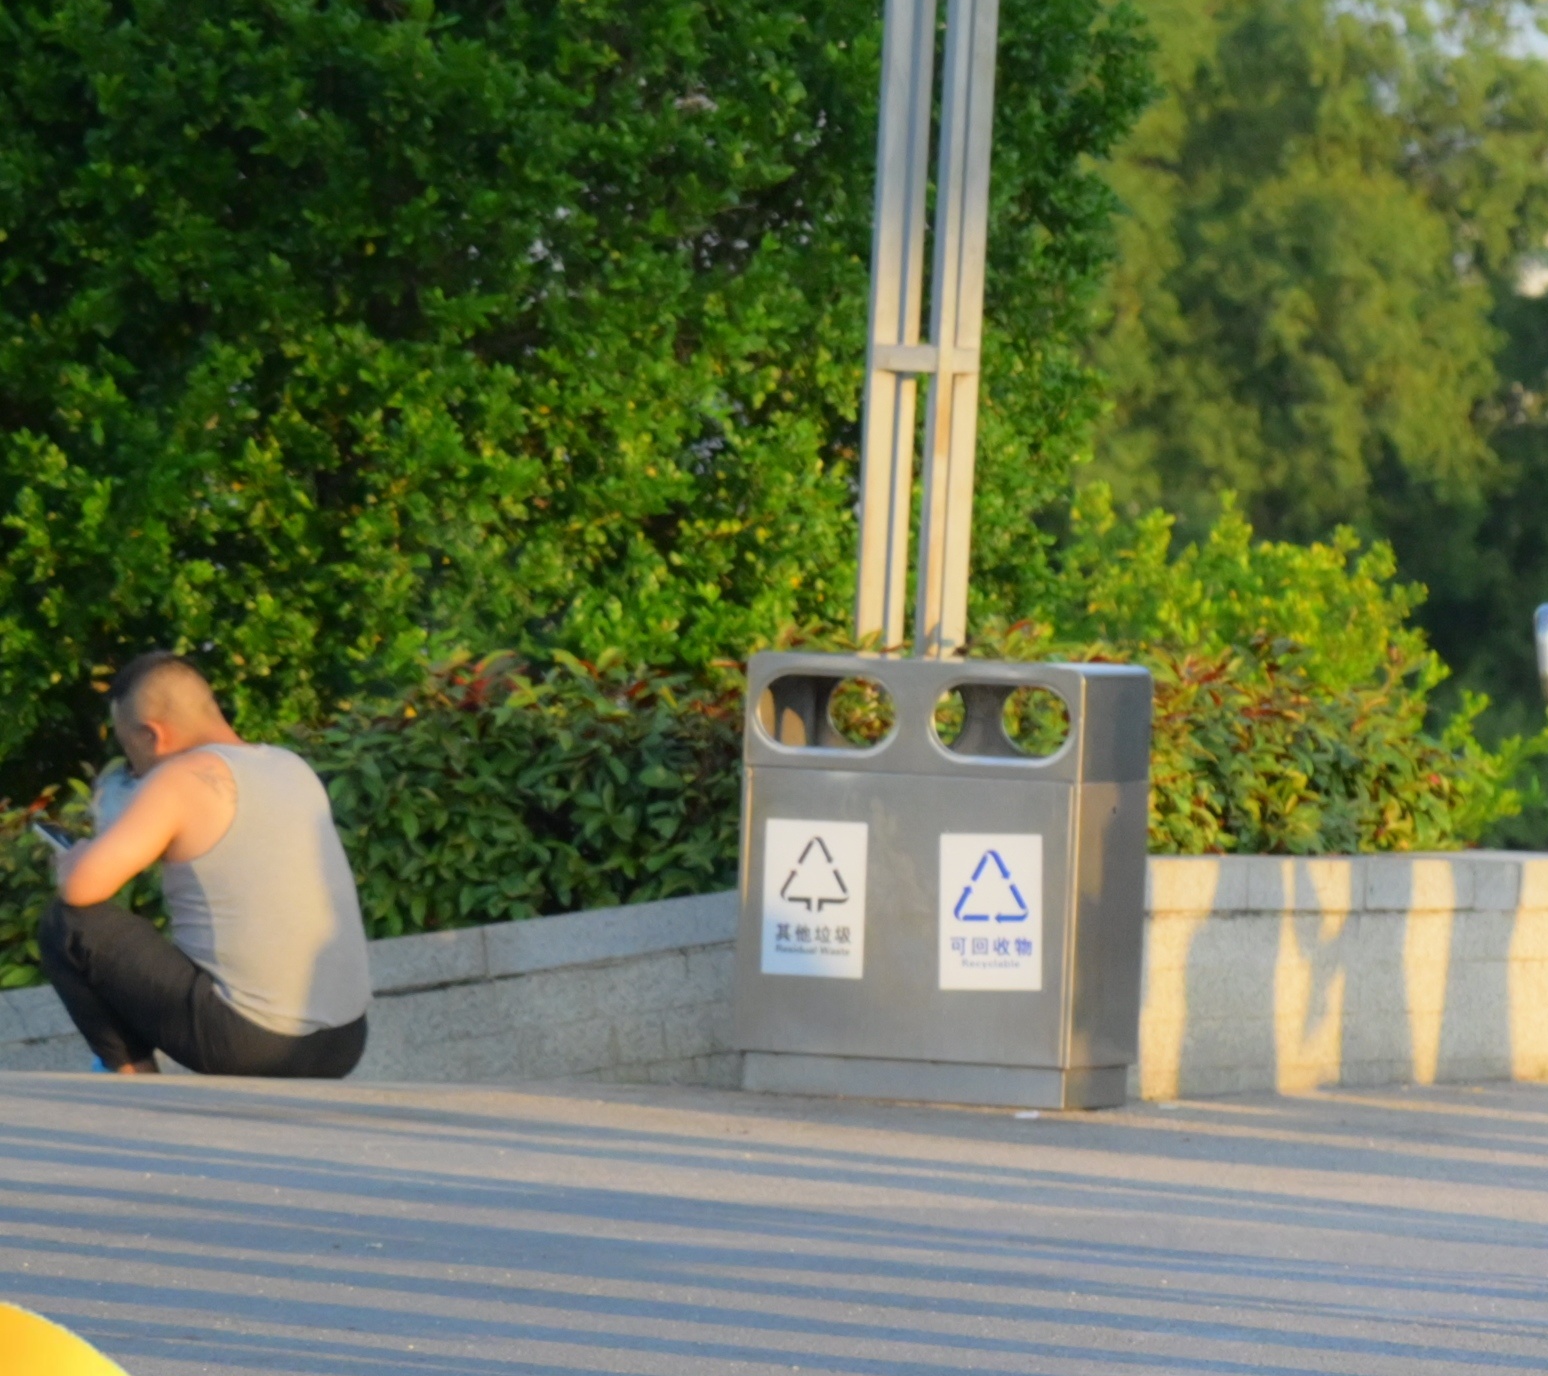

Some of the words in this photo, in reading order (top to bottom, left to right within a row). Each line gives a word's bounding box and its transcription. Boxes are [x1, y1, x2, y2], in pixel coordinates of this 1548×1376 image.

[775, 922, 852, 944] 其他垃圾
[820, 947, 850, 957] Waste
[950, 936, 1033, 957] 可回收物
[961, 959, 1020, 970] Recyclable
